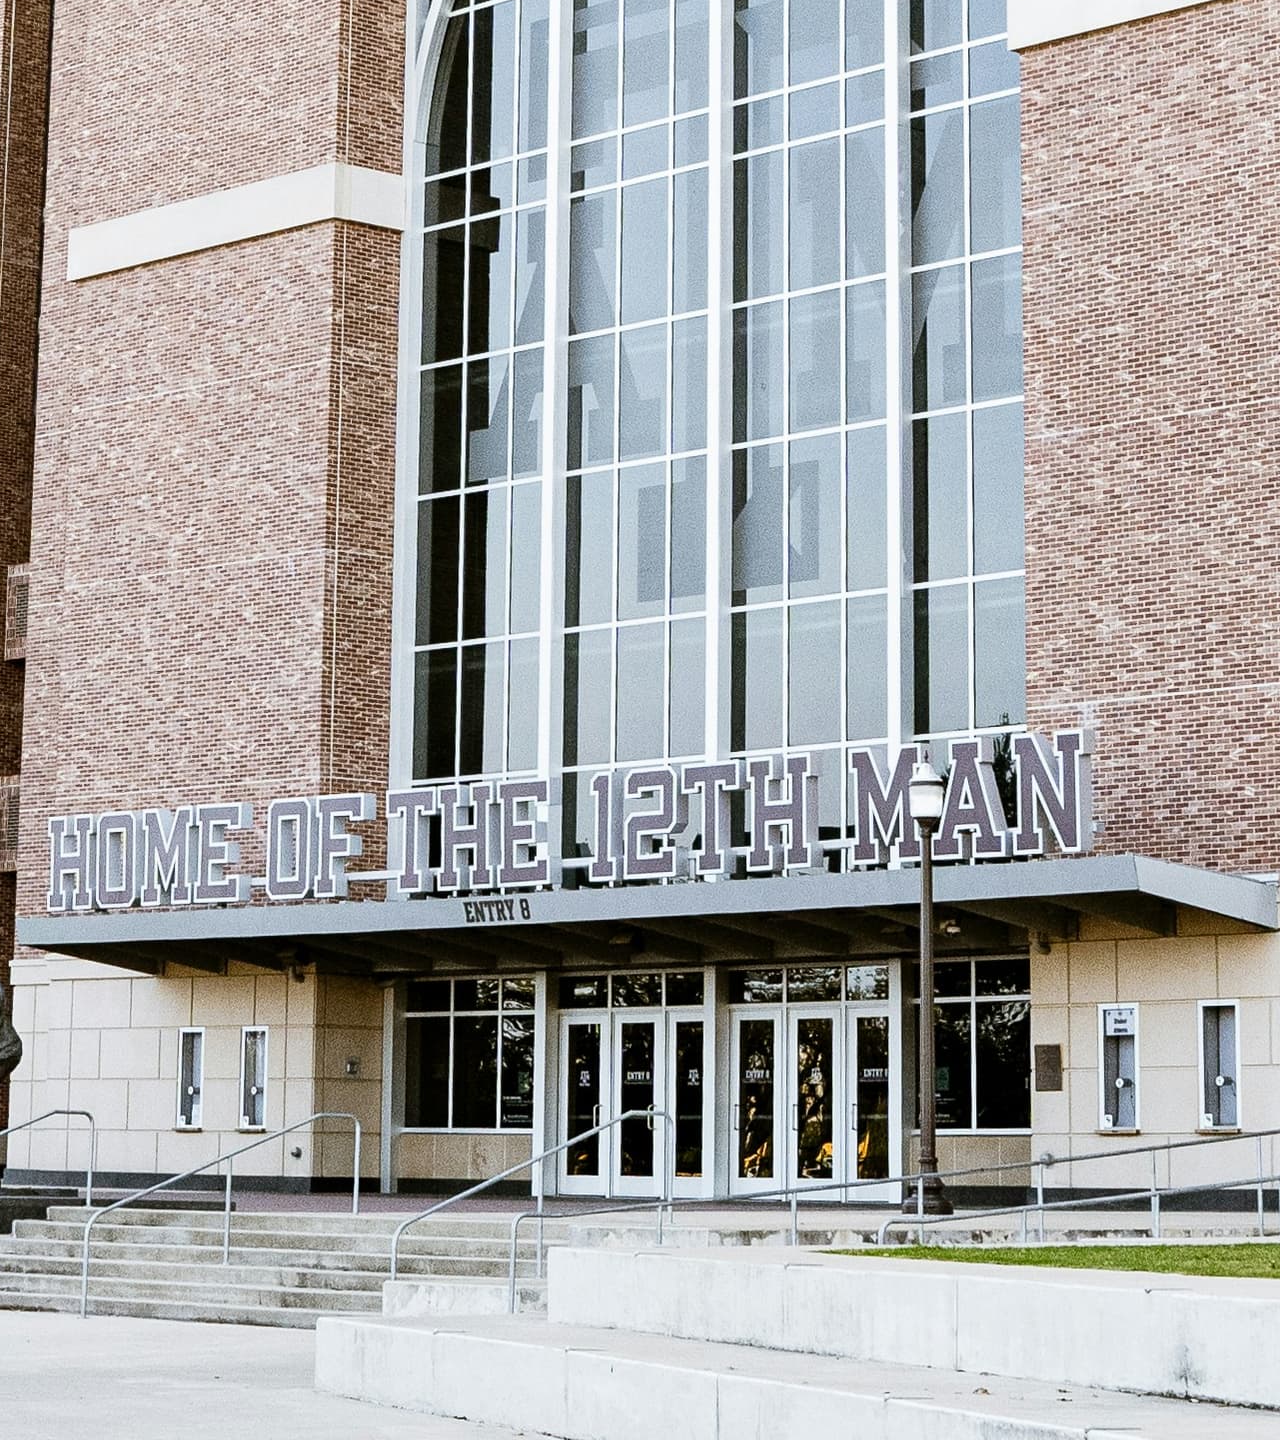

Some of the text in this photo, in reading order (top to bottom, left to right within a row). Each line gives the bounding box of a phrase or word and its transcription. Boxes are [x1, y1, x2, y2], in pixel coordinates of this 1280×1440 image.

[47, 729, 1089, 912] HOME OF THE 12TH MAN
[463, 898, 531, 923] ENTRY 8
